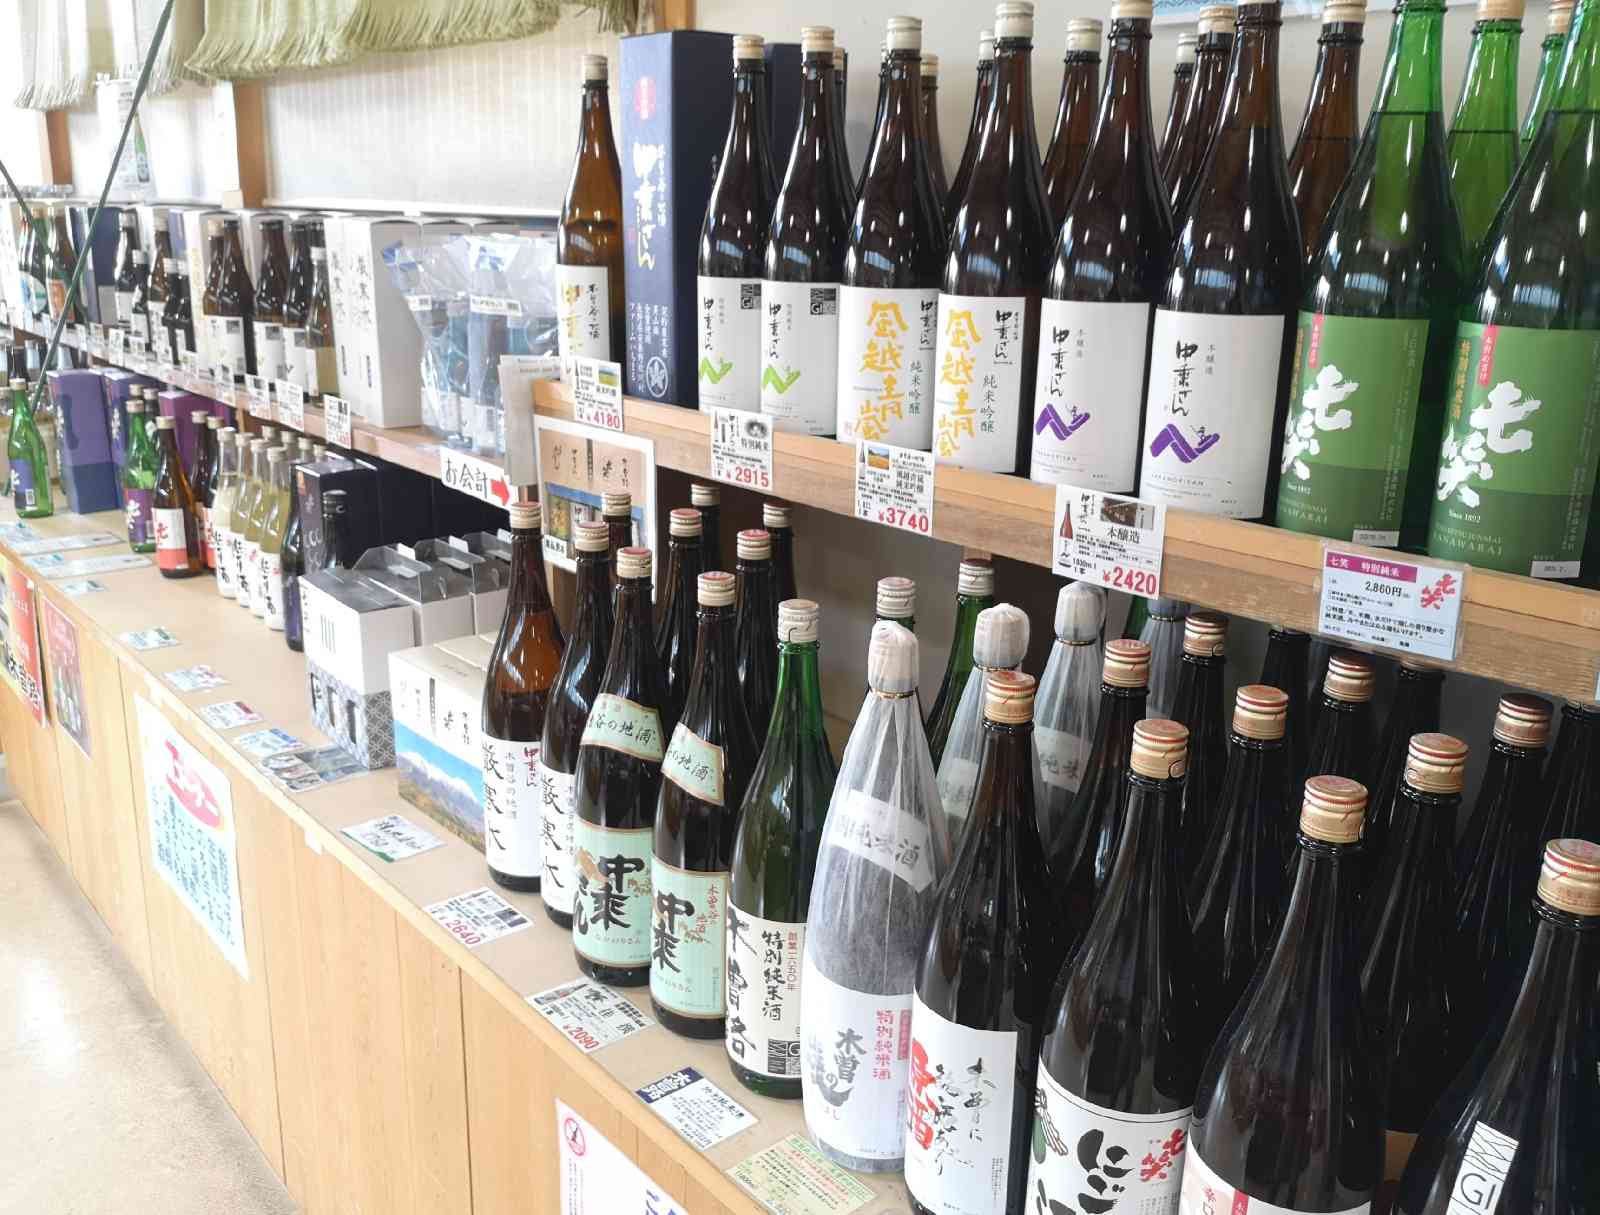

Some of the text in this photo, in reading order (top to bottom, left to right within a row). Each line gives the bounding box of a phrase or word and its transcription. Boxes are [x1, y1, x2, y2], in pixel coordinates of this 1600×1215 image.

[445, 459, 488, 499] お会計
[1107, 526, 1140, 544] 本醸造
[762, 930, 786, 1021] 特別純米酒
[1460, 1172, 1497, 1211] GI
